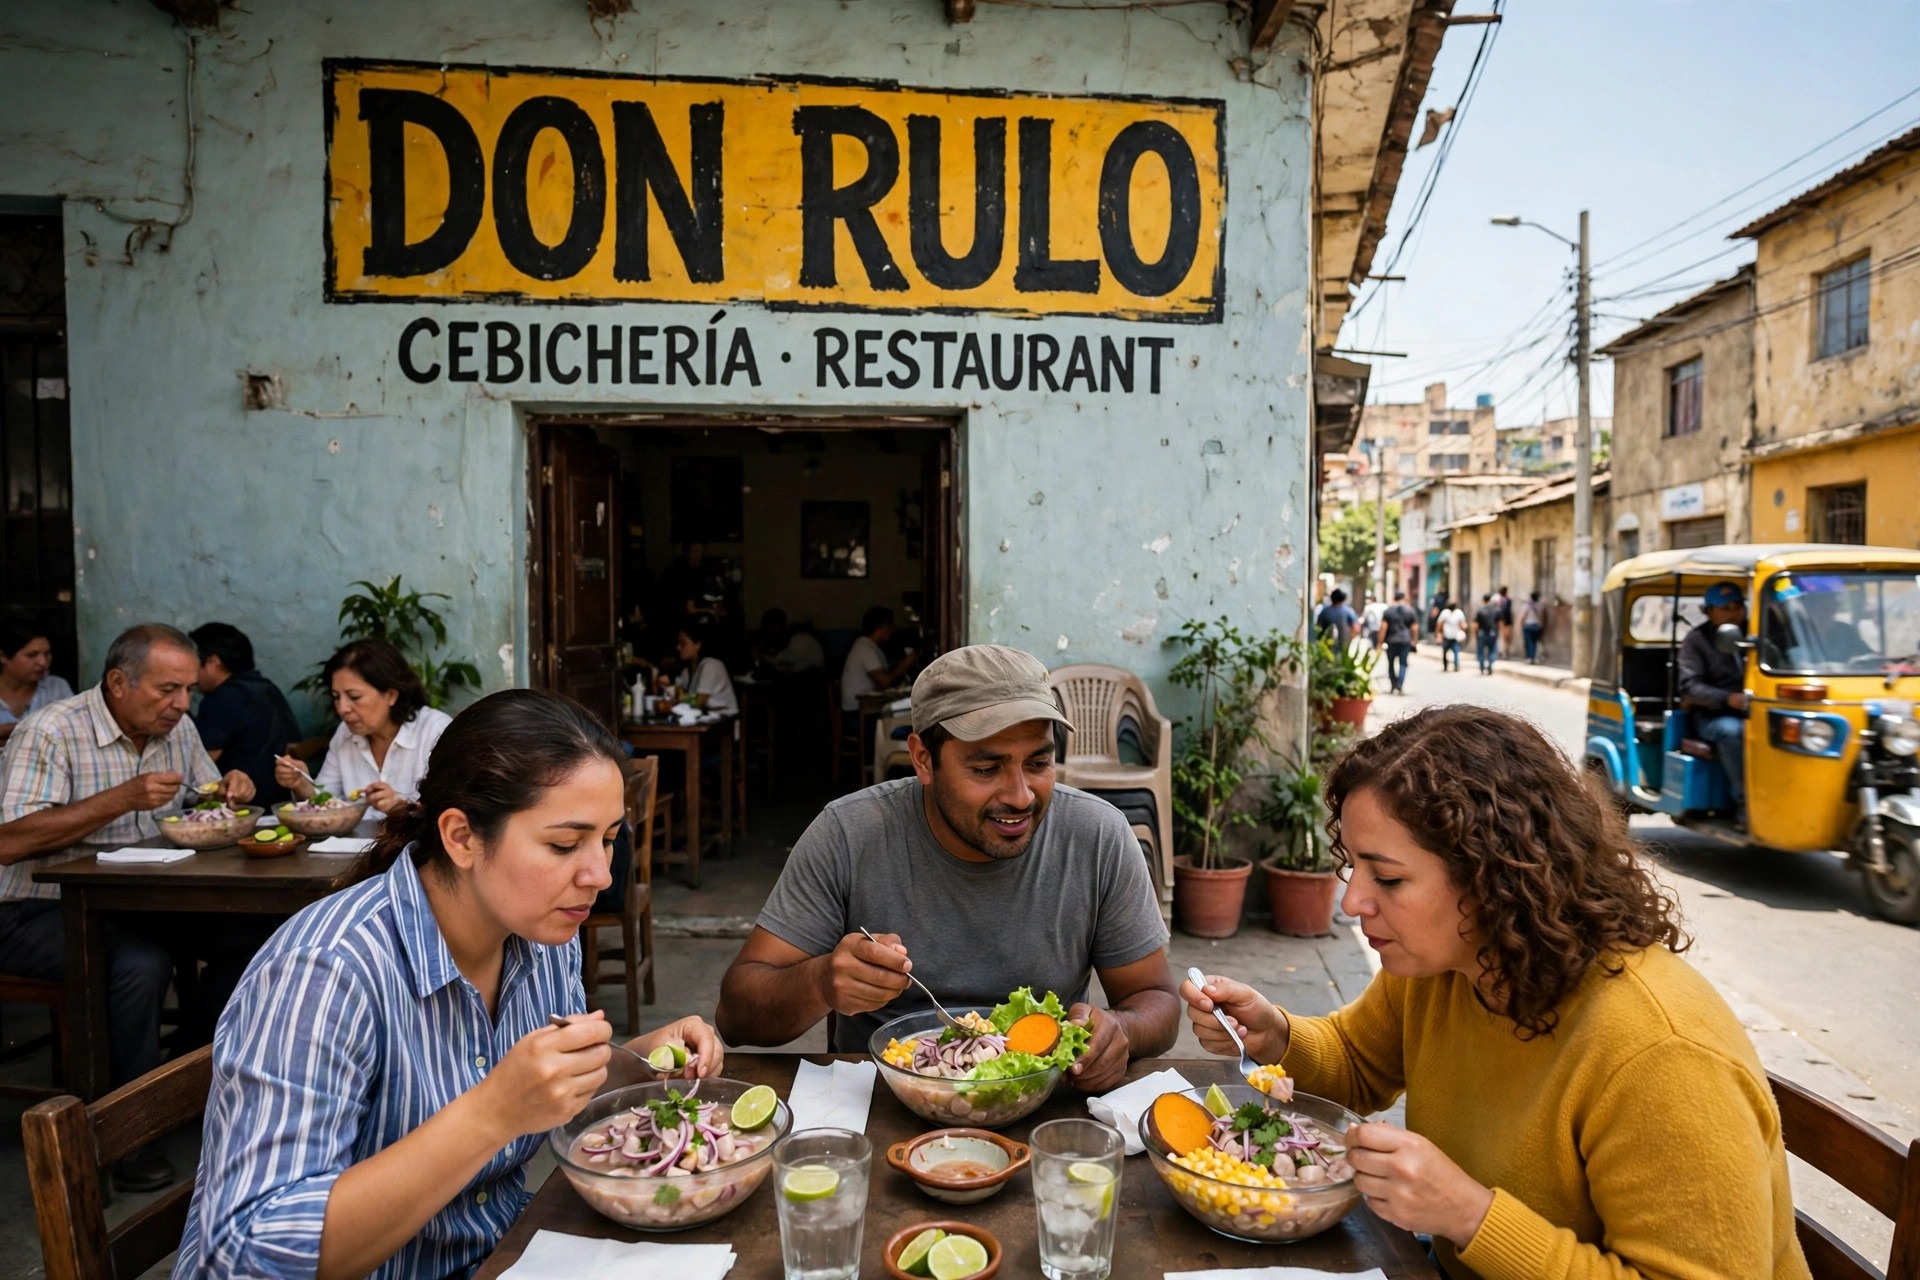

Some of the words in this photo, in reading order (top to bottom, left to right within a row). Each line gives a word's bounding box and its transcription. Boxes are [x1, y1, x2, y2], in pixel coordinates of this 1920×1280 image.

[358, 88, 724, 284] DON
[792, 105, 1201, 297] RULO
[398, 310, 761, 387] CEBICHERÍA
[814, 328, 1175, 394] RESTAURANT
